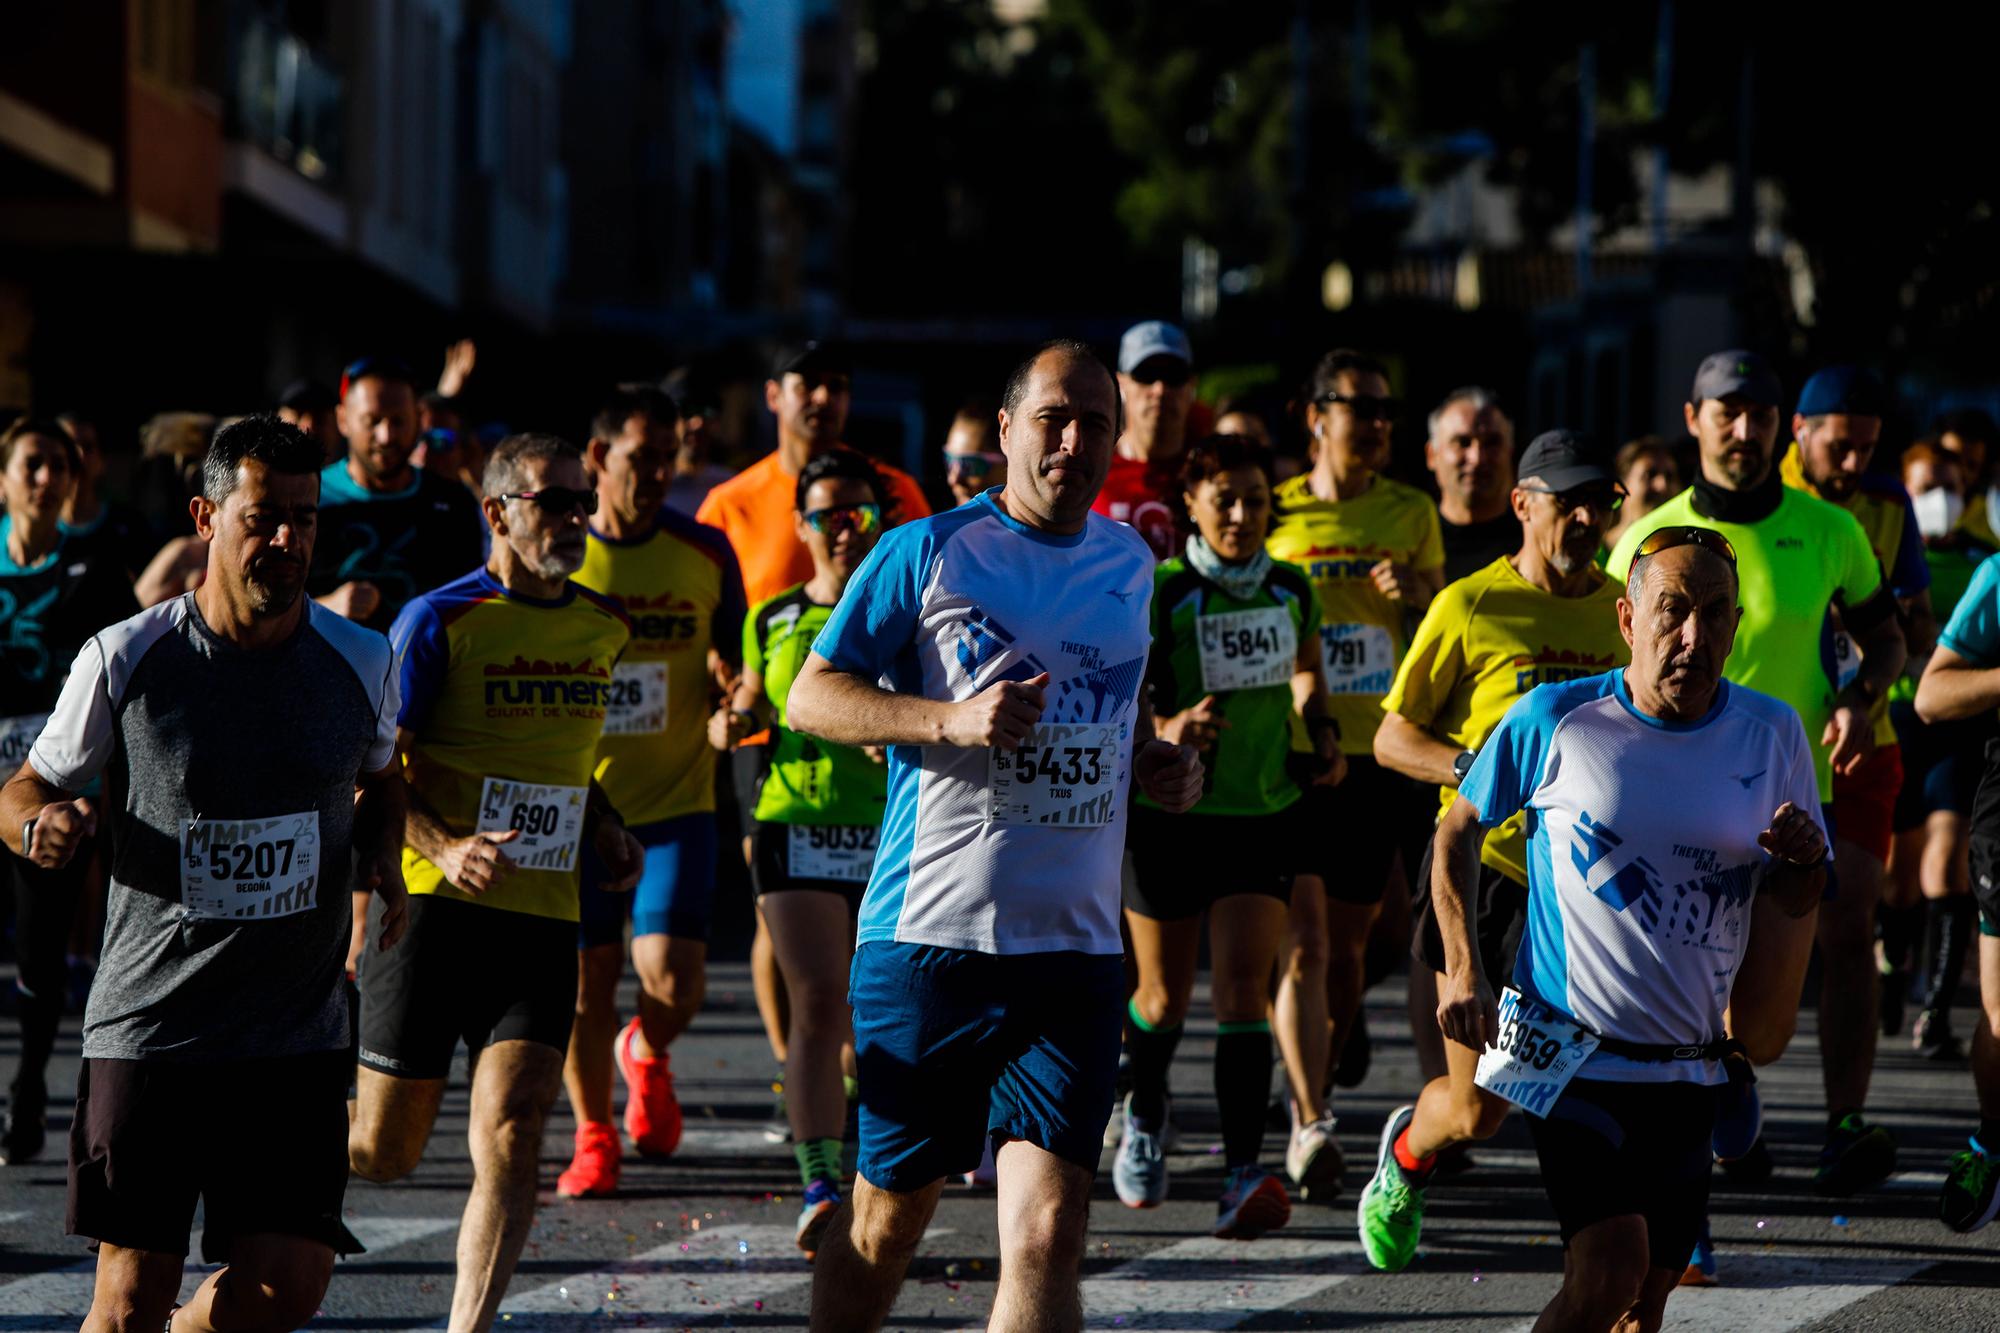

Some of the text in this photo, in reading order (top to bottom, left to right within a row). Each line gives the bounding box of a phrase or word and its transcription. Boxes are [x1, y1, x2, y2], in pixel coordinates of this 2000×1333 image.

[1061, 640, 1101, 658] THERE'S
[1222, 626, 1279, 658] 5841
[1326, 640, 1365, 665] 791
[1080, 656, 1106, 672] ONLY
[484, 680, 609, 705] runners
[612, 679, 642, 705] 26
[543, 706, 561, 718] DE
[1016, 746, 1101, 785] 5433
[1049, 788, 1072, 799] TXUS
[510, 803, 559, 836] 690
[810, 825, 876, 850] 5032
[210, 839, 295, 880] 5207
[1672, 844, 1717, 861] THERE'S
[1695, 859, 1722, 874] ONLY
[236, 880, 271, 893] BEGOÑA
[1500, 1019, 1561, 1070] 5959
